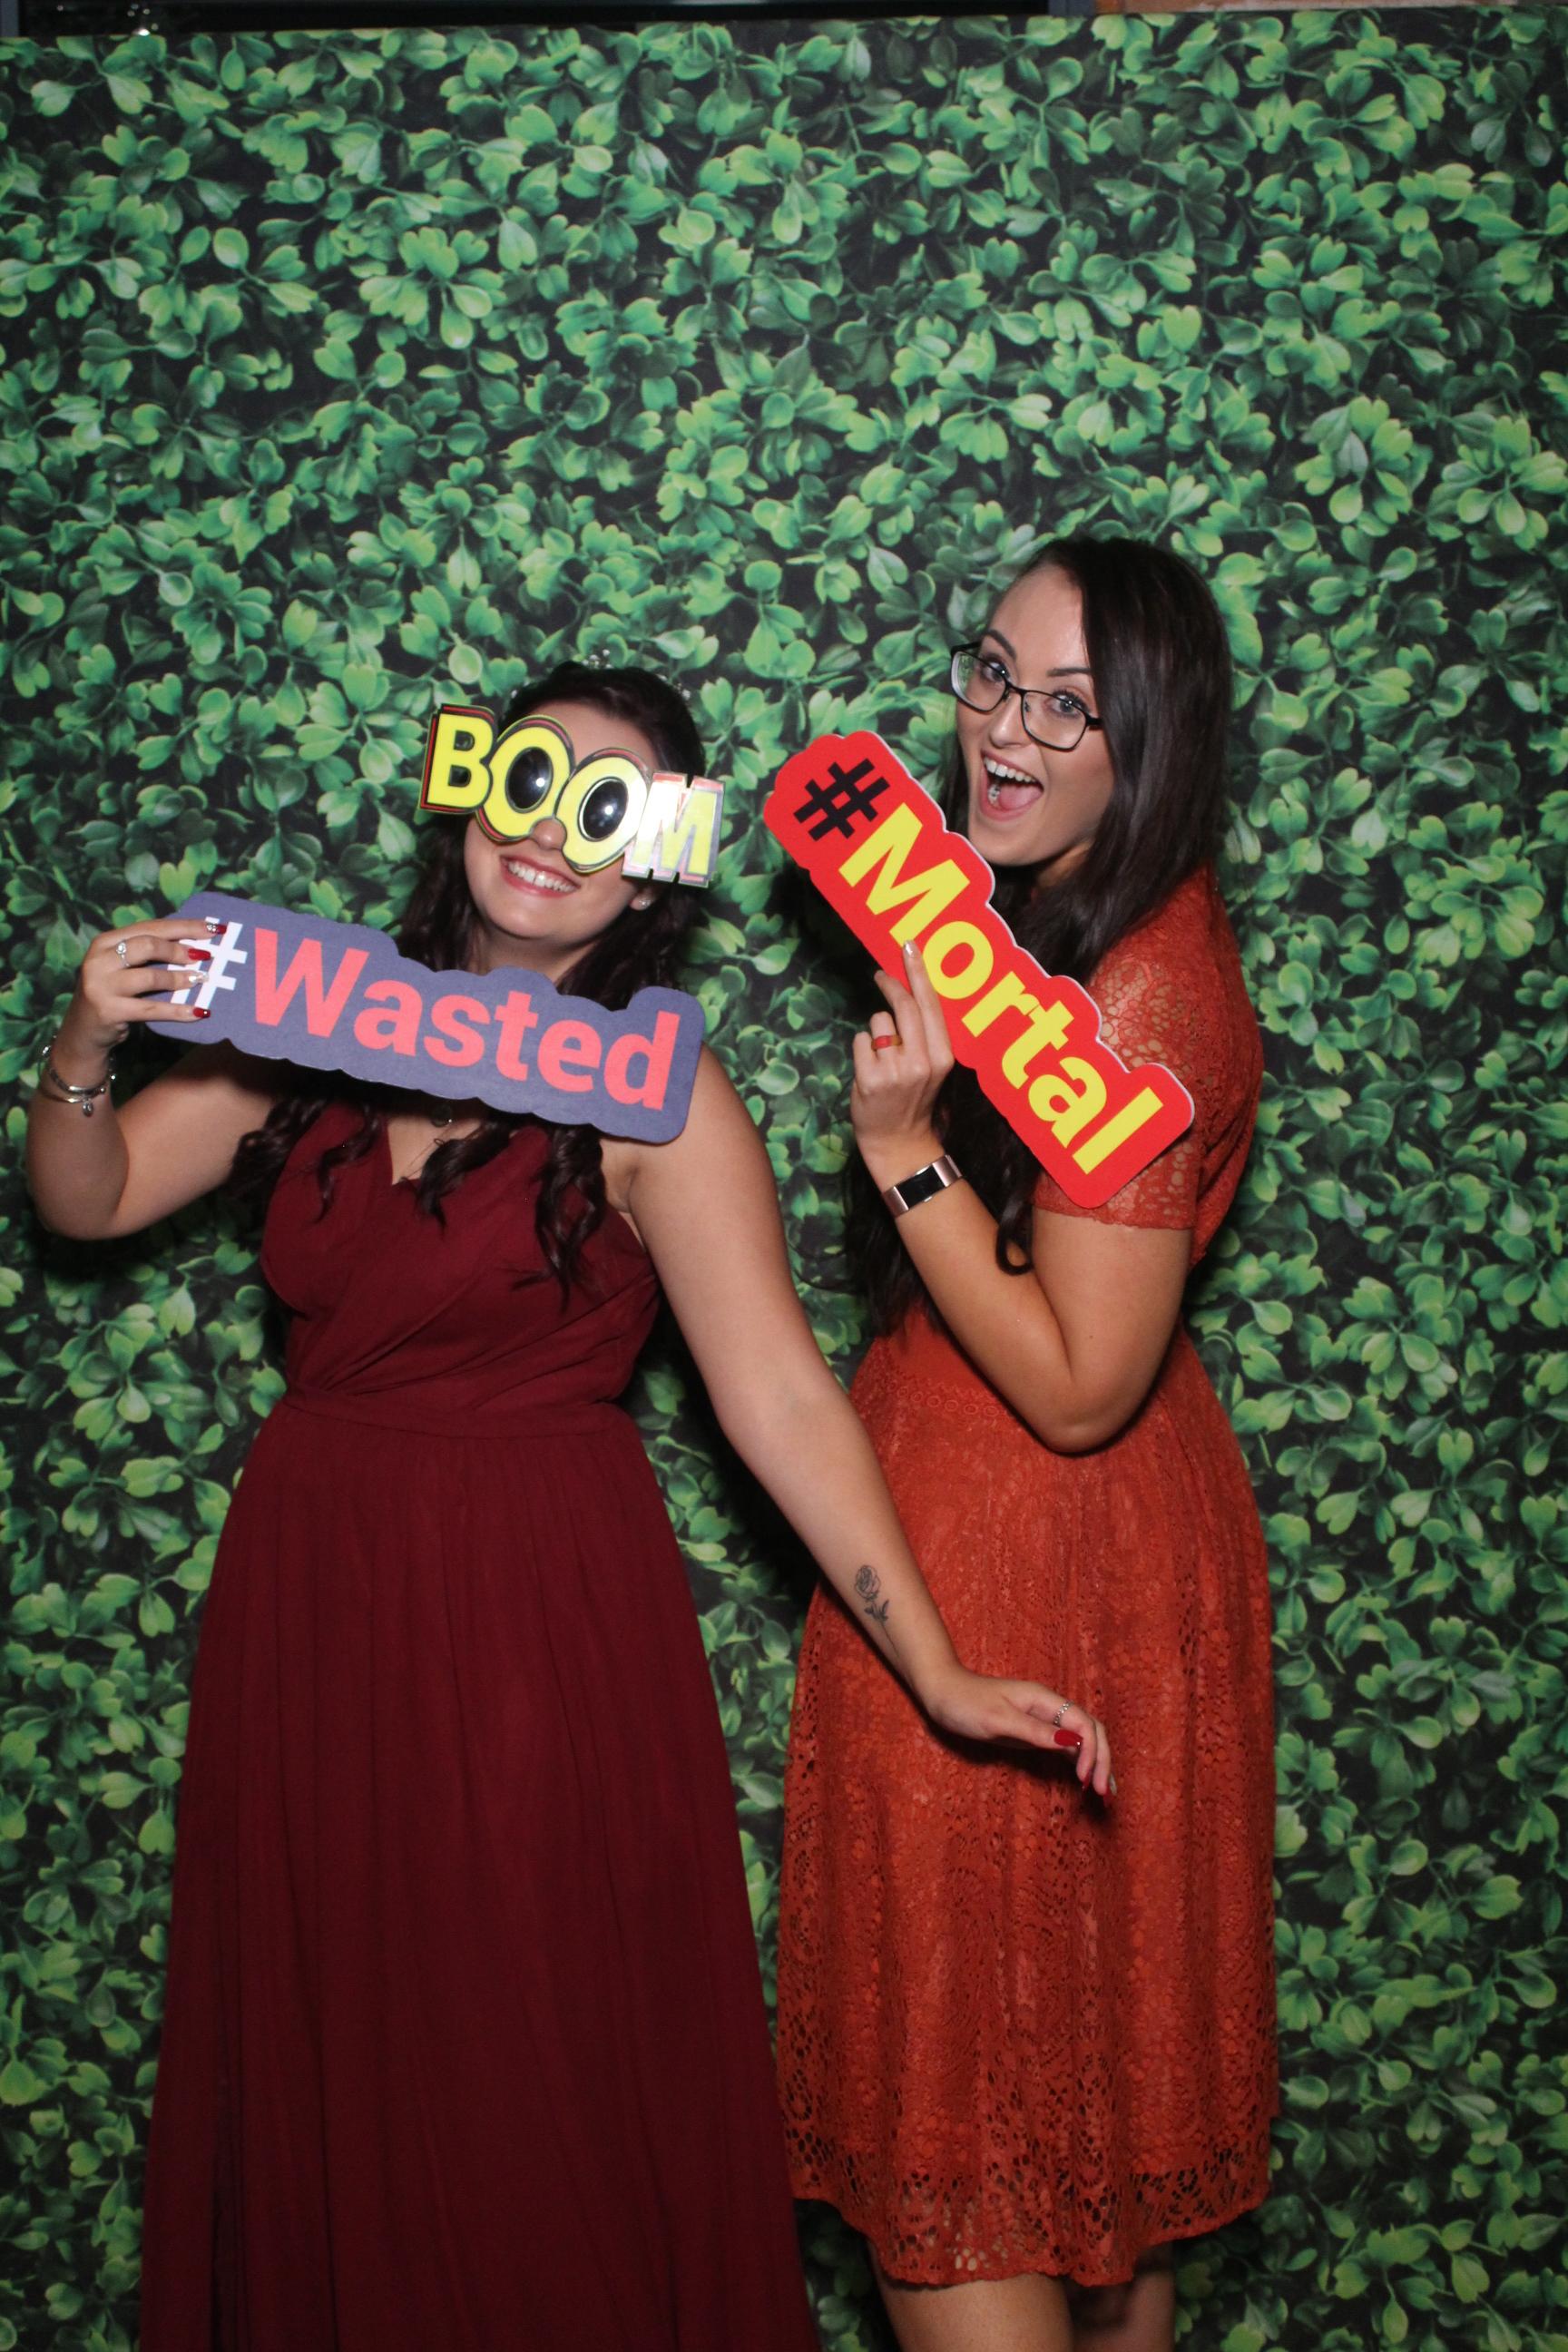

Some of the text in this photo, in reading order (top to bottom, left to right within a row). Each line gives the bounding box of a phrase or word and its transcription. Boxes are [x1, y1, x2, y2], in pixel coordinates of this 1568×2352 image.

[423, 706, 723, 886] BOOM
[167, 916, 681, 1111] #Wasted
[793, 758, 1163, 1175] #Mortal
